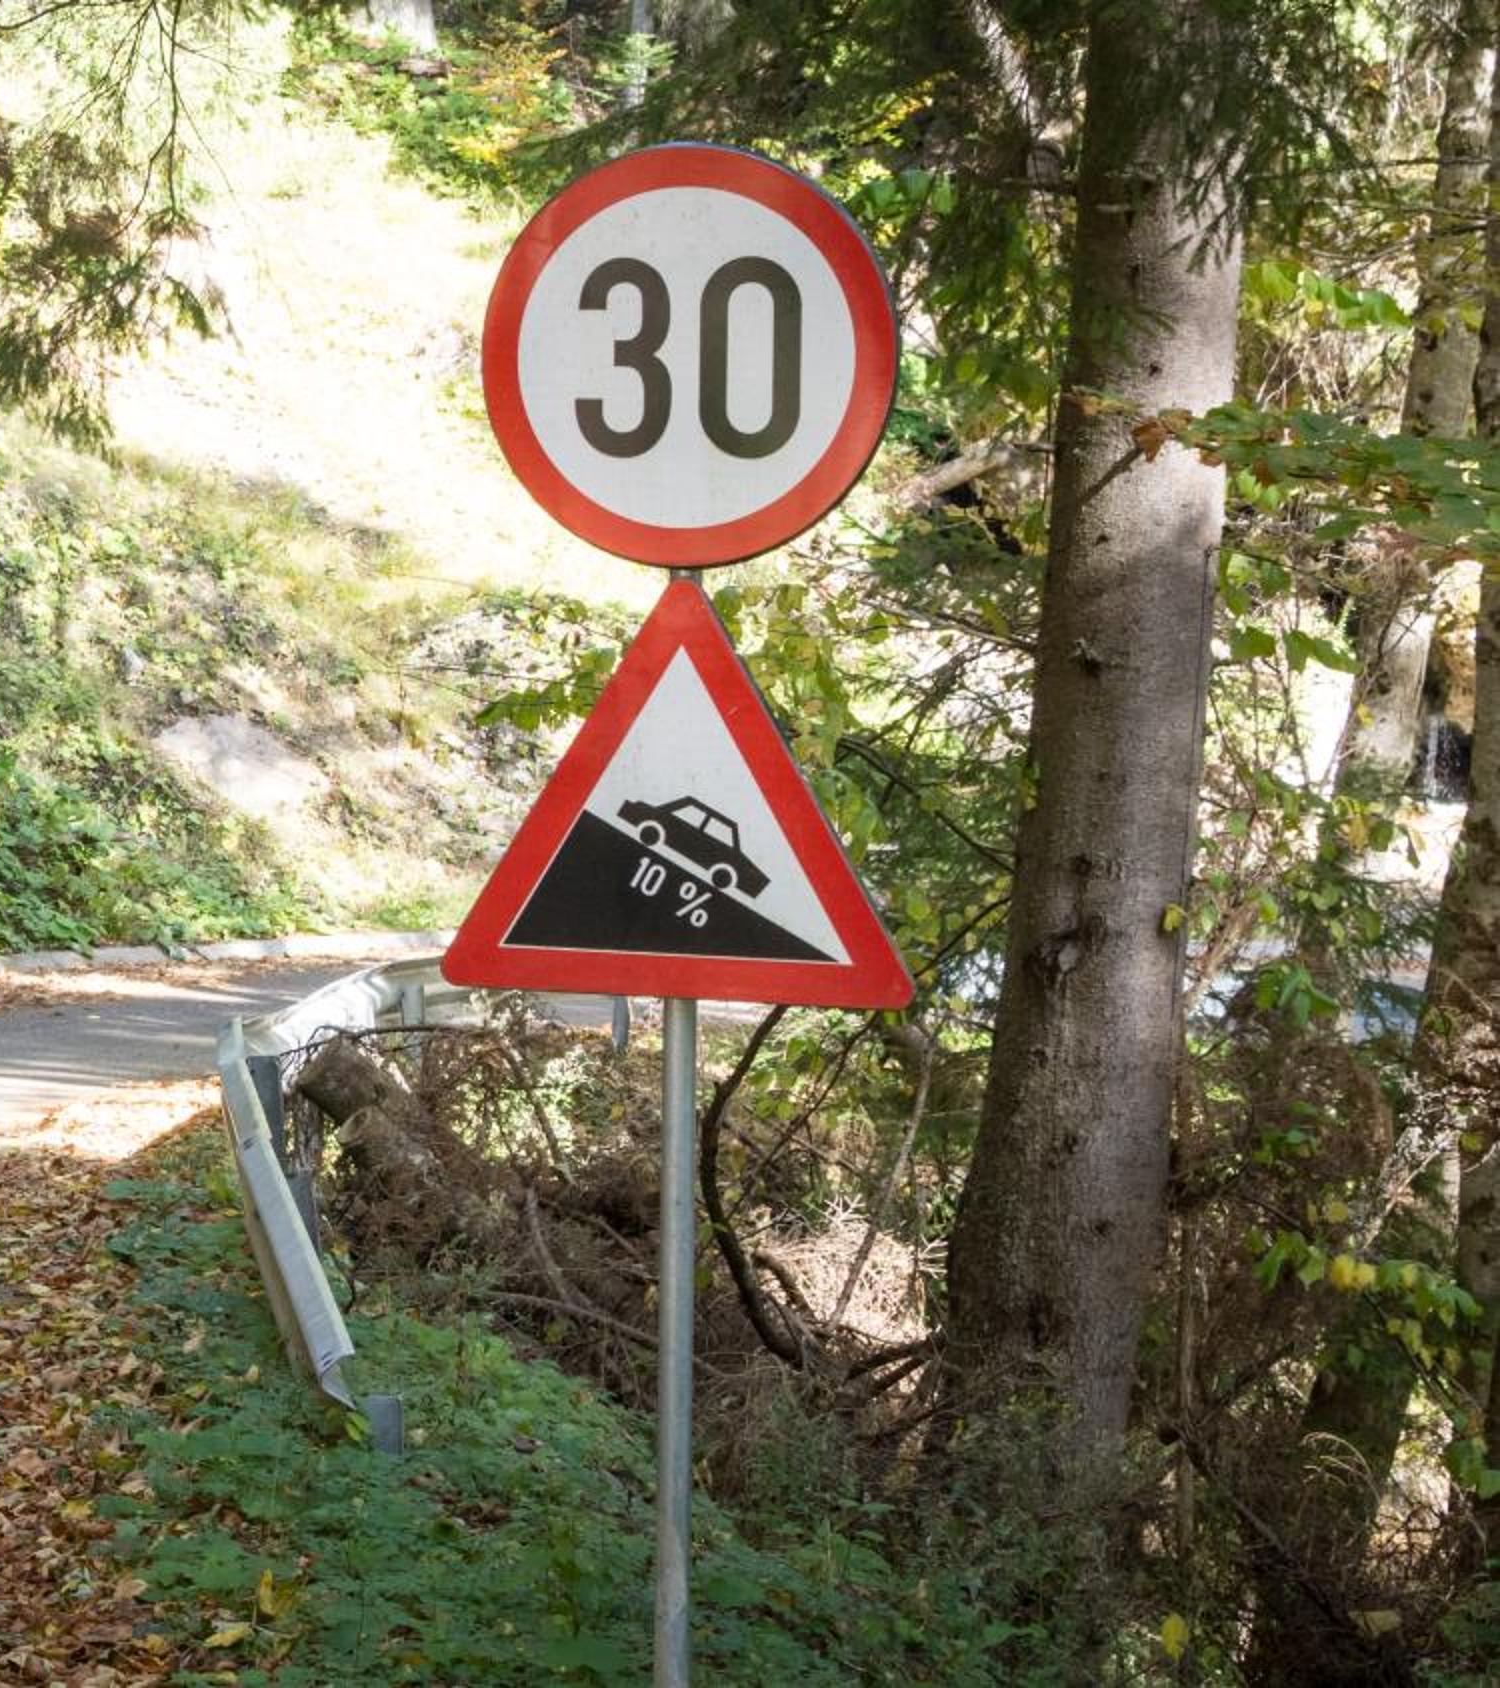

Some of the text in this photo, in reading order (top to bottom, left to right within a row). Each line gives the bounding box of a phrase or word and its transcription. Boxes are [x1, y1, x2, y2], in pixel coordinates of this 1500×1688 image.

[574, 255, 803, 459] 30
[629, 857, 712, 928] 10 %
